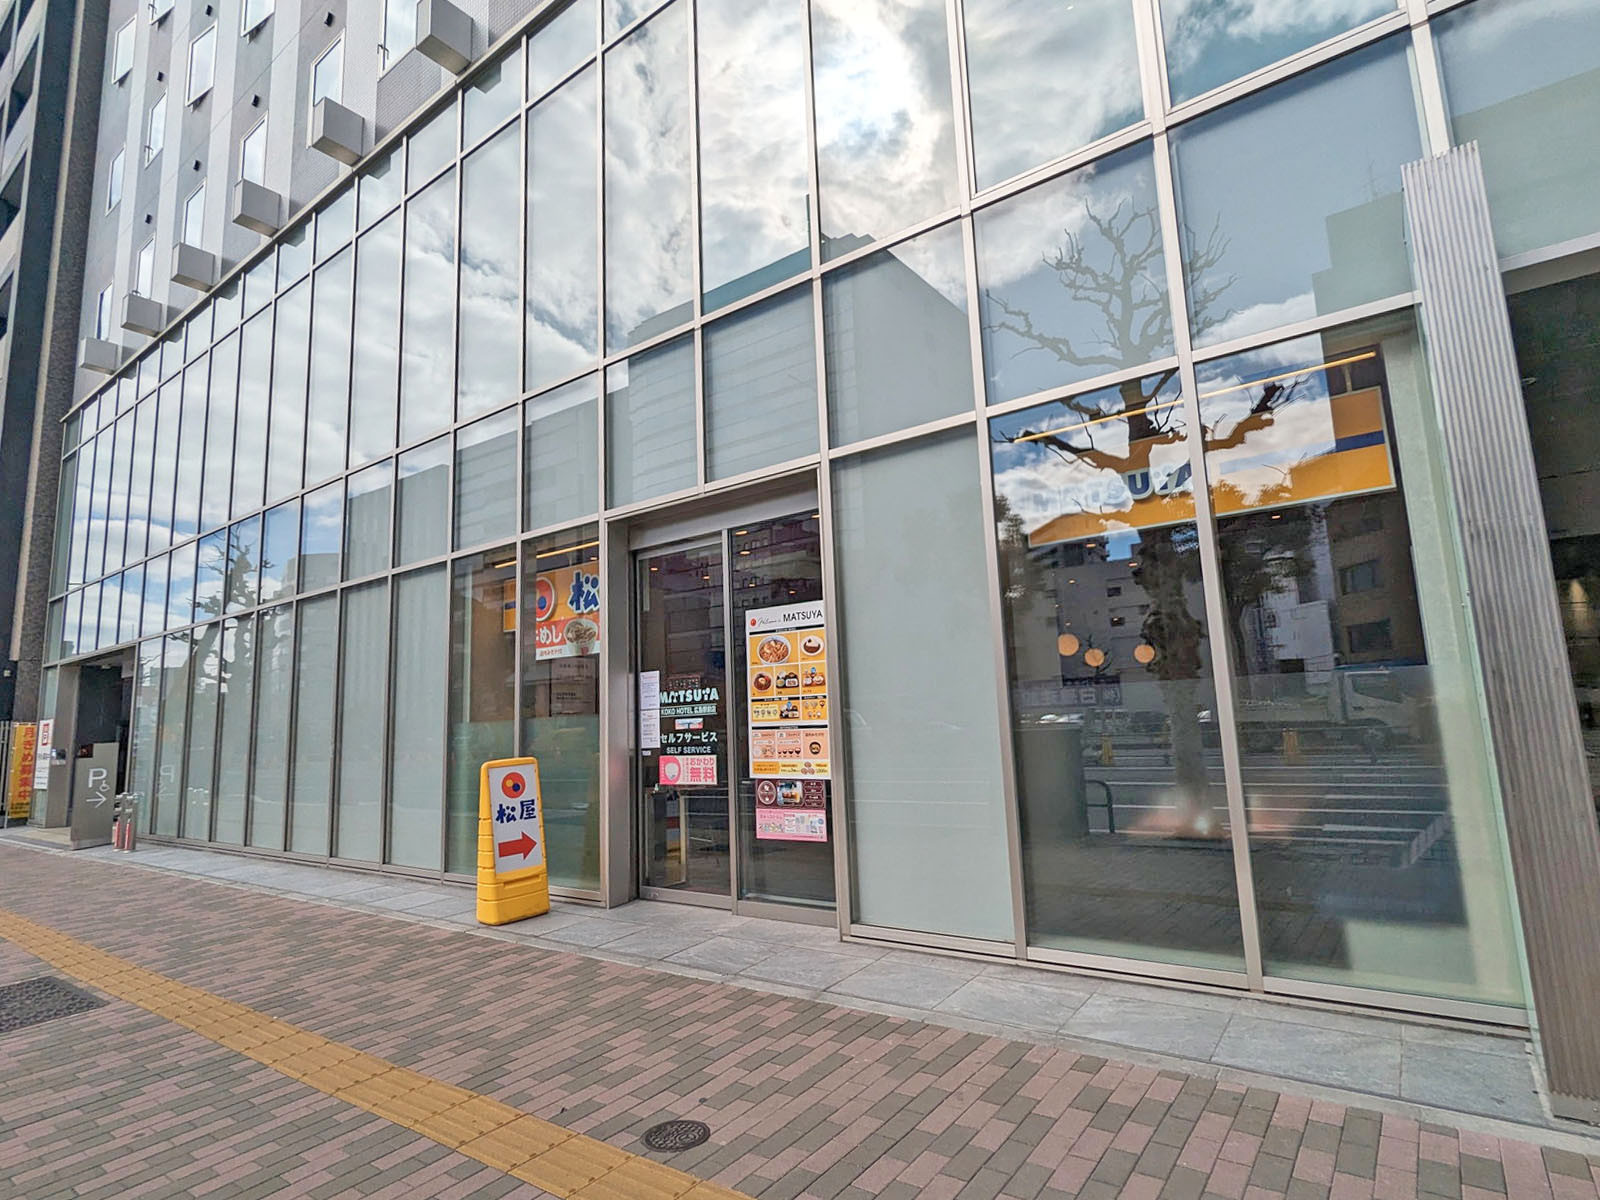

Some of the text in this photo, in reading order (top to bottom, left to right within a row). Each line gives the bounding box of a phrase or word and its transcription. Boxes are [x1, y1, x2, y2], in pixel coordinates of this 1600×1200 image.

[568, 570, 600, 613] 松
[783, 609, 823, 622] MATSUYA
[536, 624, 562, 644] めし
[660, 687, 720, 704] MATSUYA
[676, 706, 693, 715] HOTEL
[661, 731, 718, 744] セルフサービス
[683, 745, 712, 754] SERVICE
[690, 757, 715, 766] おかわり
[88, 767, 107, 788] P
[690, 766, 715, 783] 無料
[495, 798, 537, 824] 松屋
